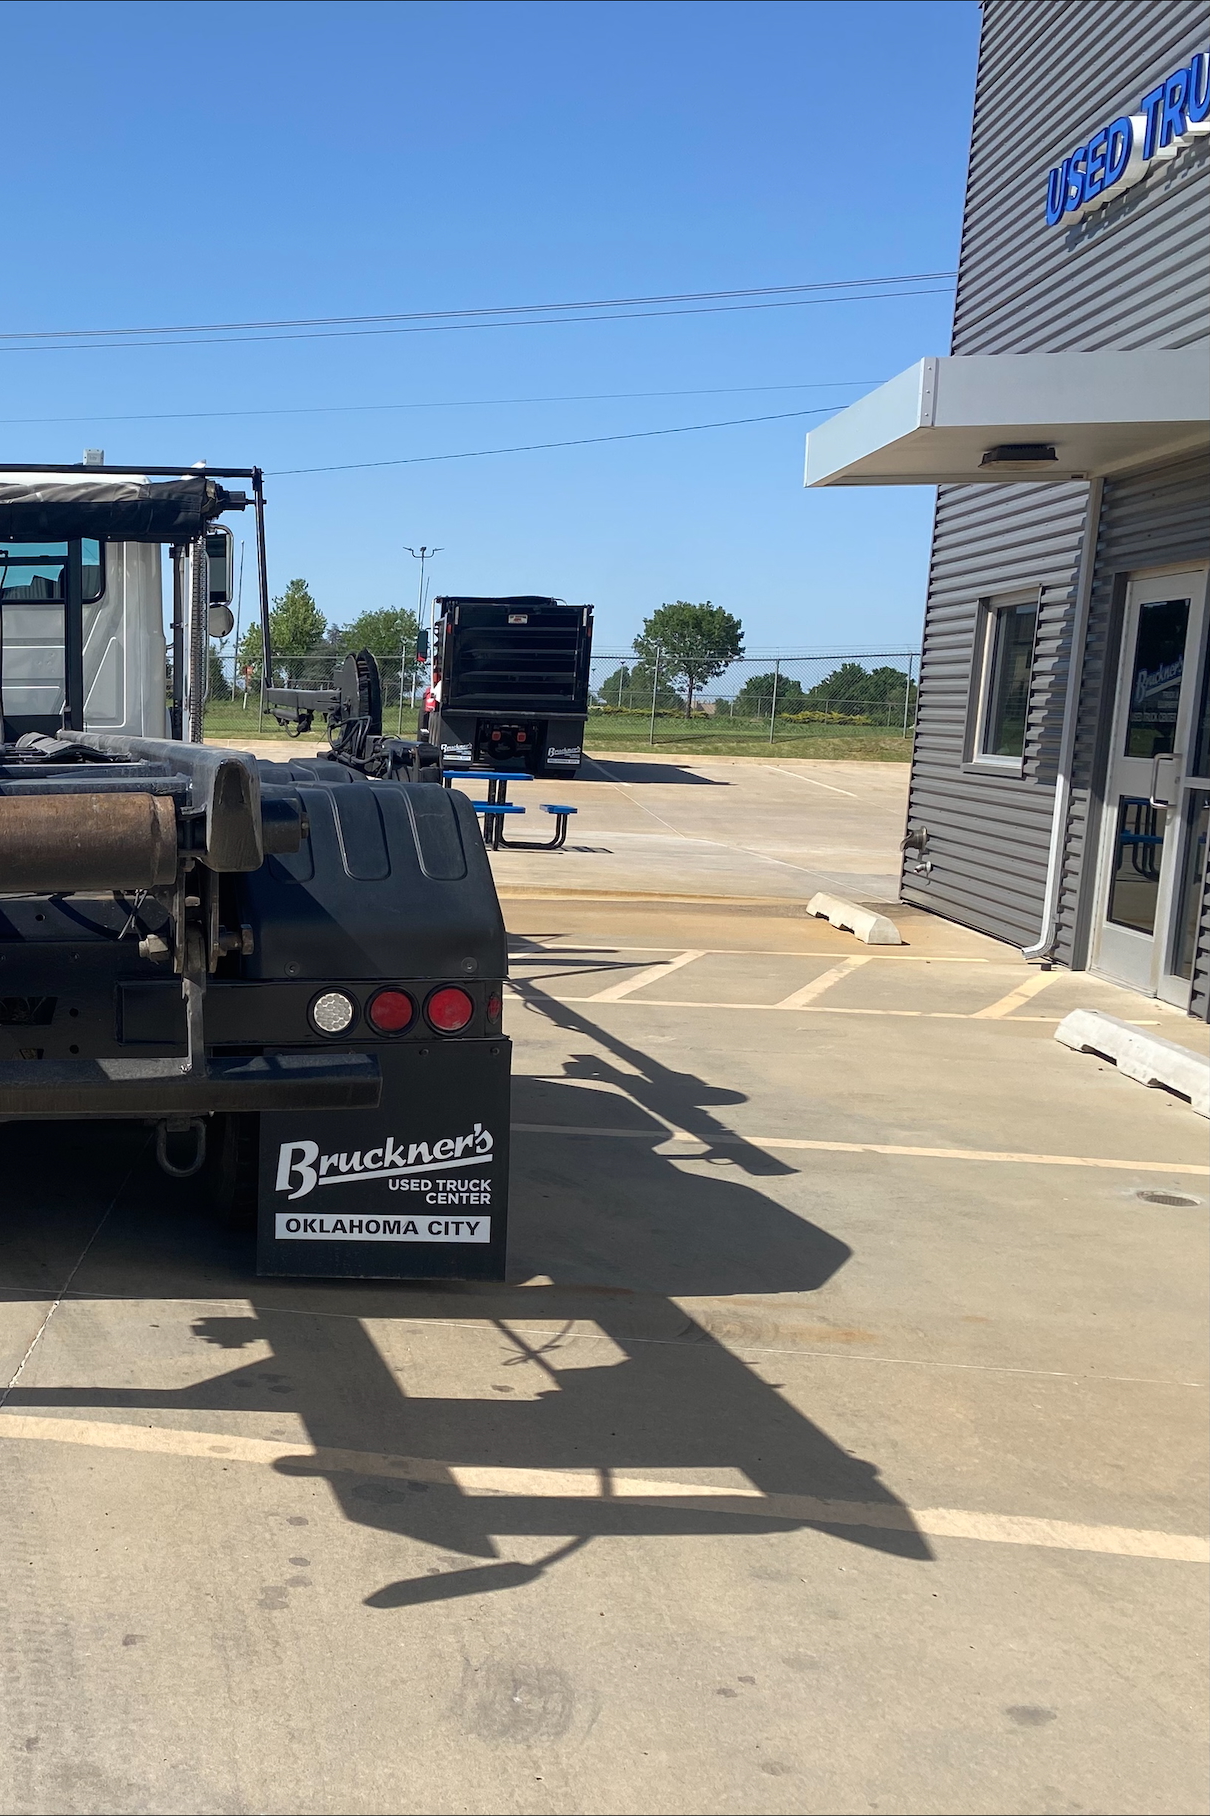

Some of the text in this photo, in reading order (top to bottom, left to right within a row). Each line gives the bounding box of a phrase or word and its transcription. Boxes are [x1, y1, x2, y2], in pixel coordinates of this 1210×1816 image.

[1046, 115, 1132, 226] USED
[275, 1123, 494, 1200] Bruckner's
[388, 1179, 492, 1192] USED TRUCK
[425, 1192, 491, 1205] CENTER
[285, 1218, 481, 1236] OKLAHOMA CITY
